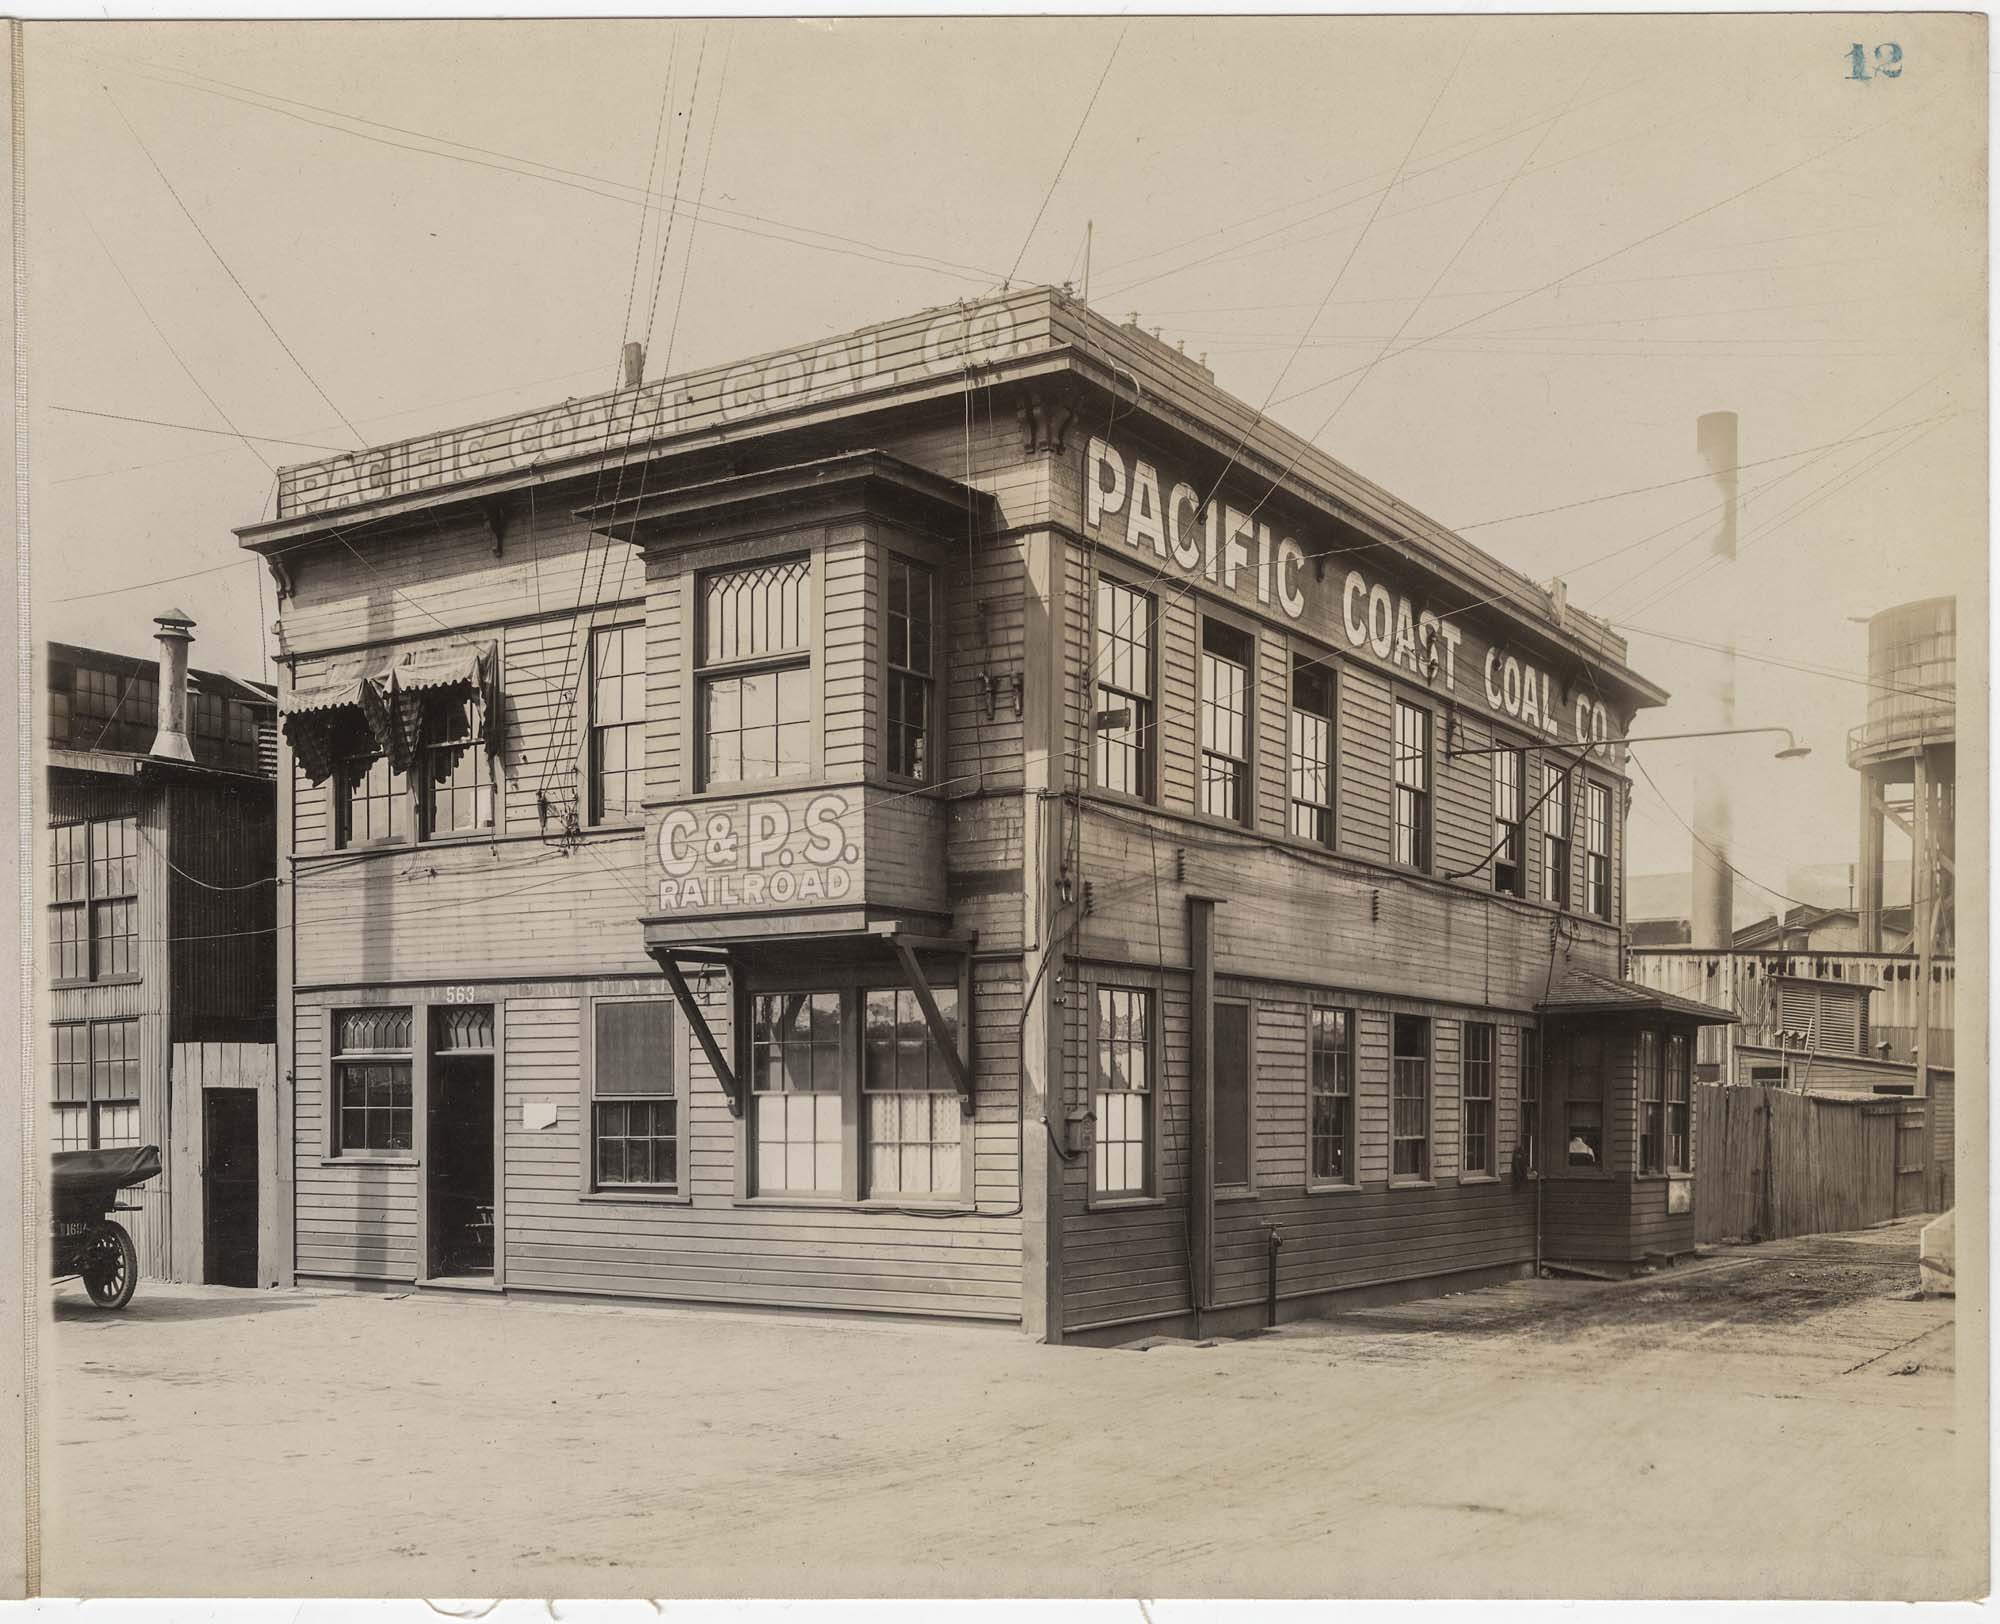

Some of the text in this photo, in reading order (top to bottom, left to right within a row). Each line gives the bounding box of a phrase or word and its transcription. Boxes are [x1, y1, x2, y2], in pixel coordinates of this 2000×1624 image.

[294, 422, 491, 516] PACIFIC
[719, 328, 898, 422] COAL
[1087, 436, 1306, 619] PACIFIC
[1341, 569, 1464, 692] COAST
[1483, 645, 1559, 736] COAL
[658, 866, 852, 912] RAILROAD
[446, 986, 475, 1003] 563
